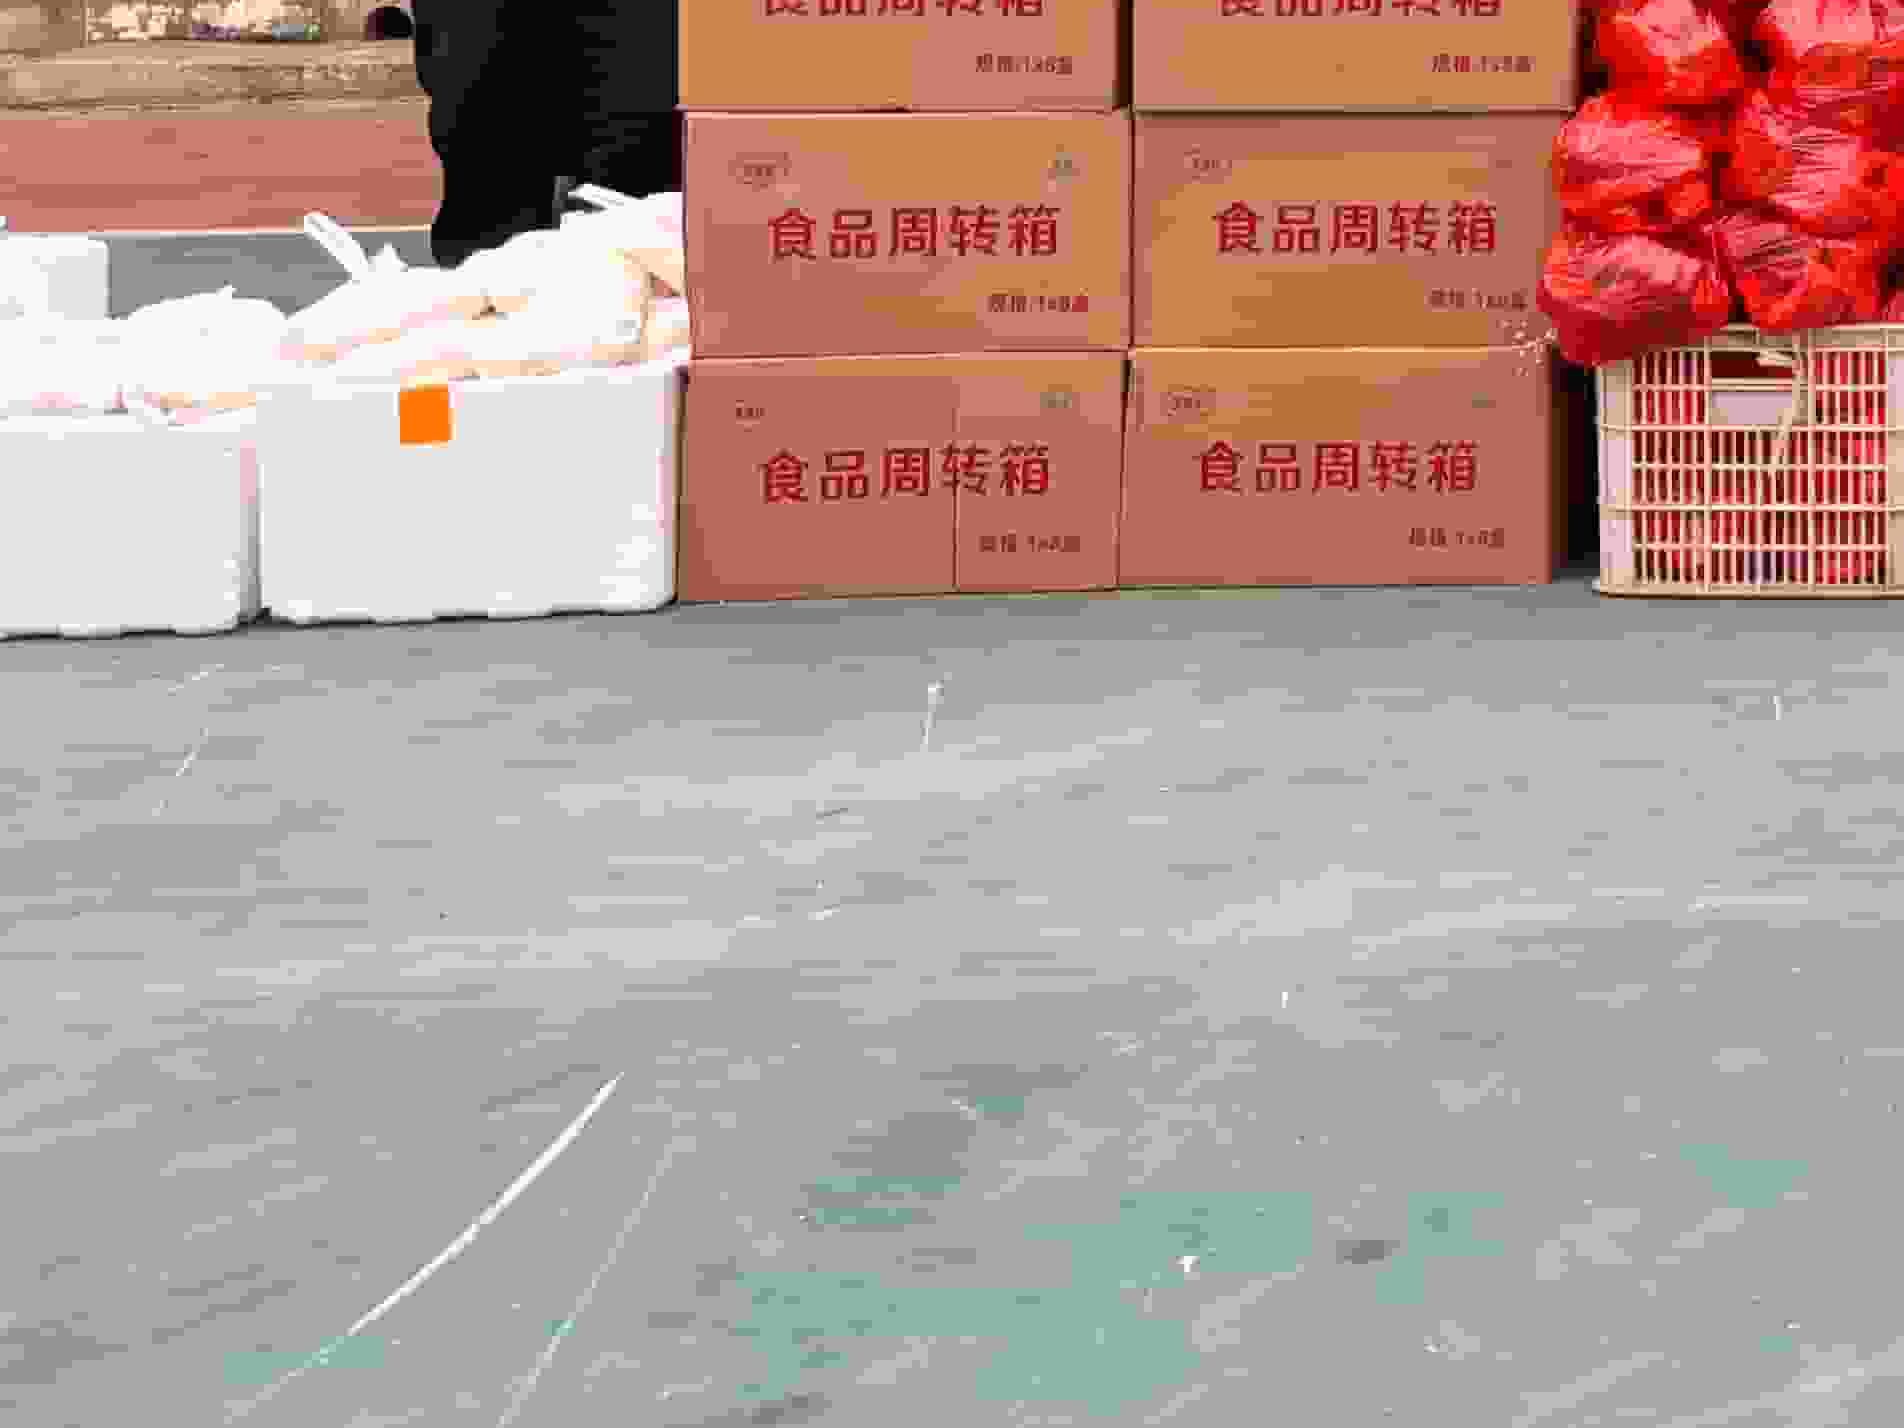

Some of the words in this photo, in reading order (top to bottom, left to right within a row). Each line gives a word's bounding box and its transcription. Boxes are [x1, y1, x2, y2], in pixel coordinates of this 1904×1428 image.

[768, 202, 1060, 264] 食品周转箱
[1212, 200, 1497, 257] 食品周转箱
[757, 444, 1050, 504] 食品周转箱
[1192, 441, 1479, 494] 食品周转箱
